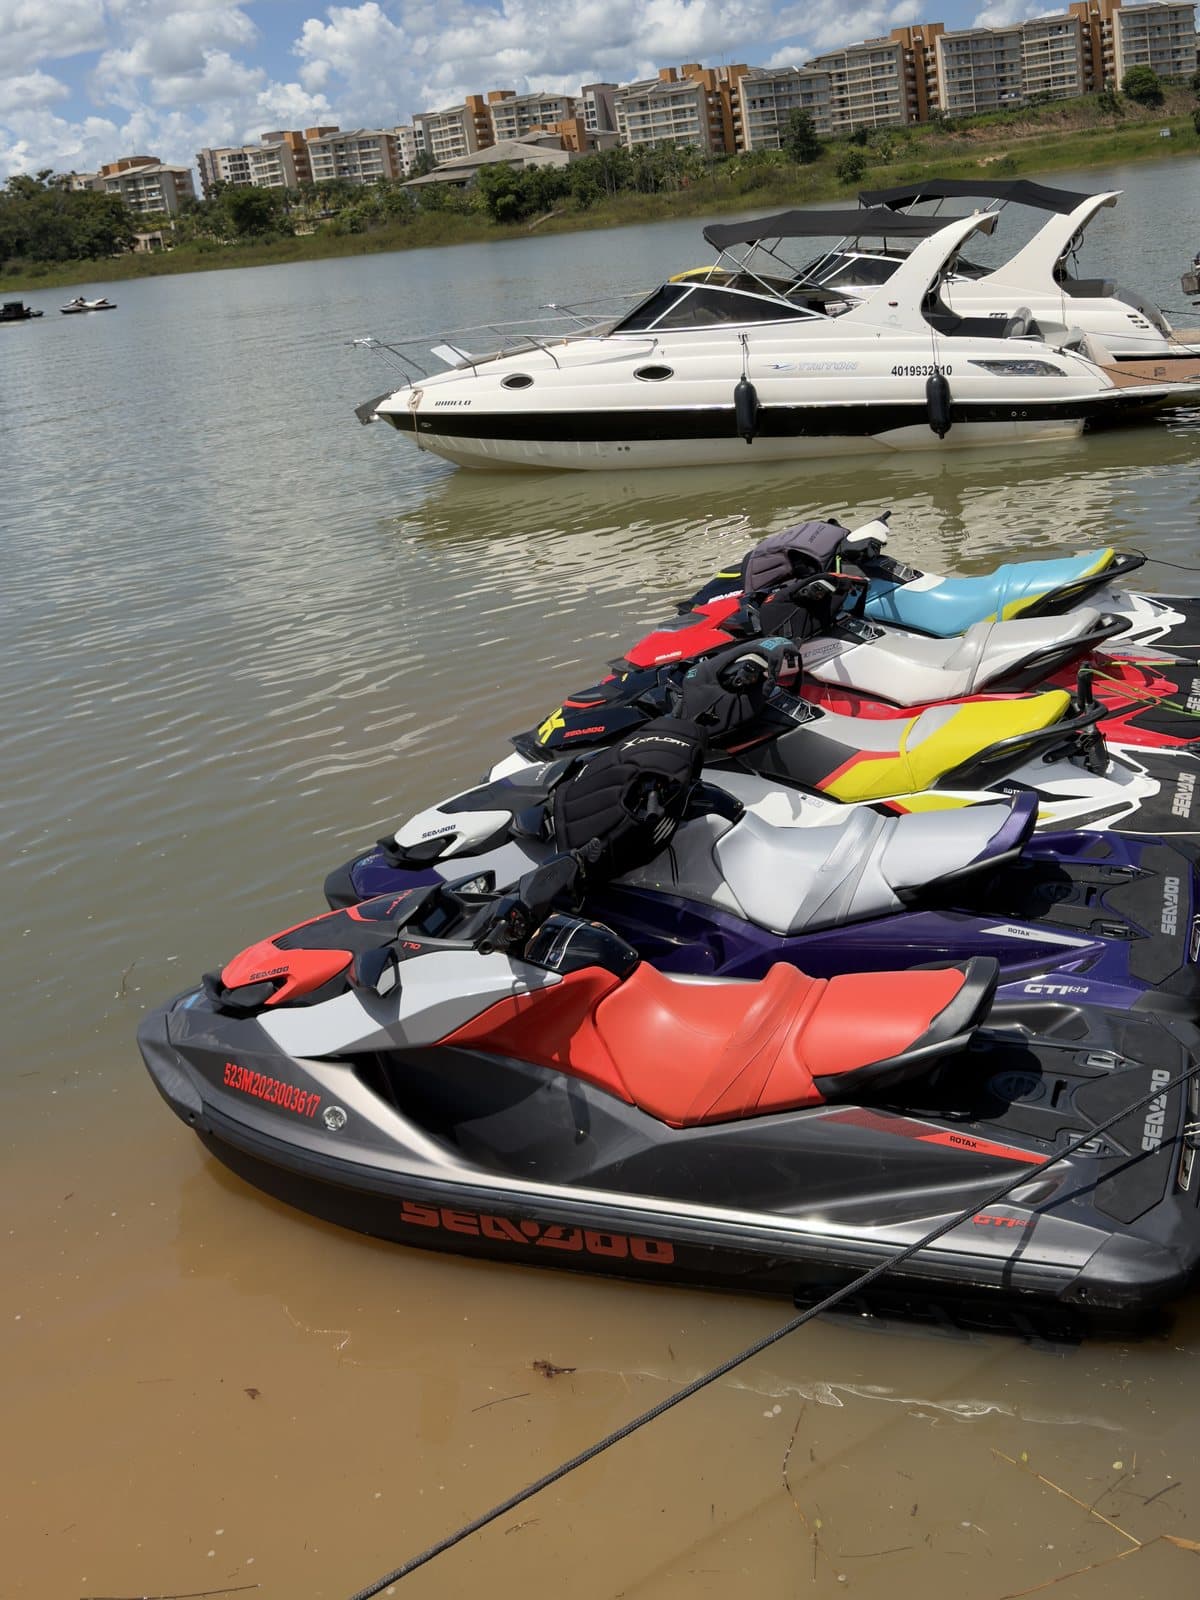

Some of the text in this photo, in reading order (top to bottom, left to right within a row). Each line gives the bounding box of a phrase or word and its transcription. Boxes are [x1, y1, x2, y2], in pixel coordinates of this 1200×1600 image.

[891, 365, 953, 376] 401993210
[223, 1062, 321, 1119] 523M2023003617
[949, 1135, 977, 1148] ROTAX
